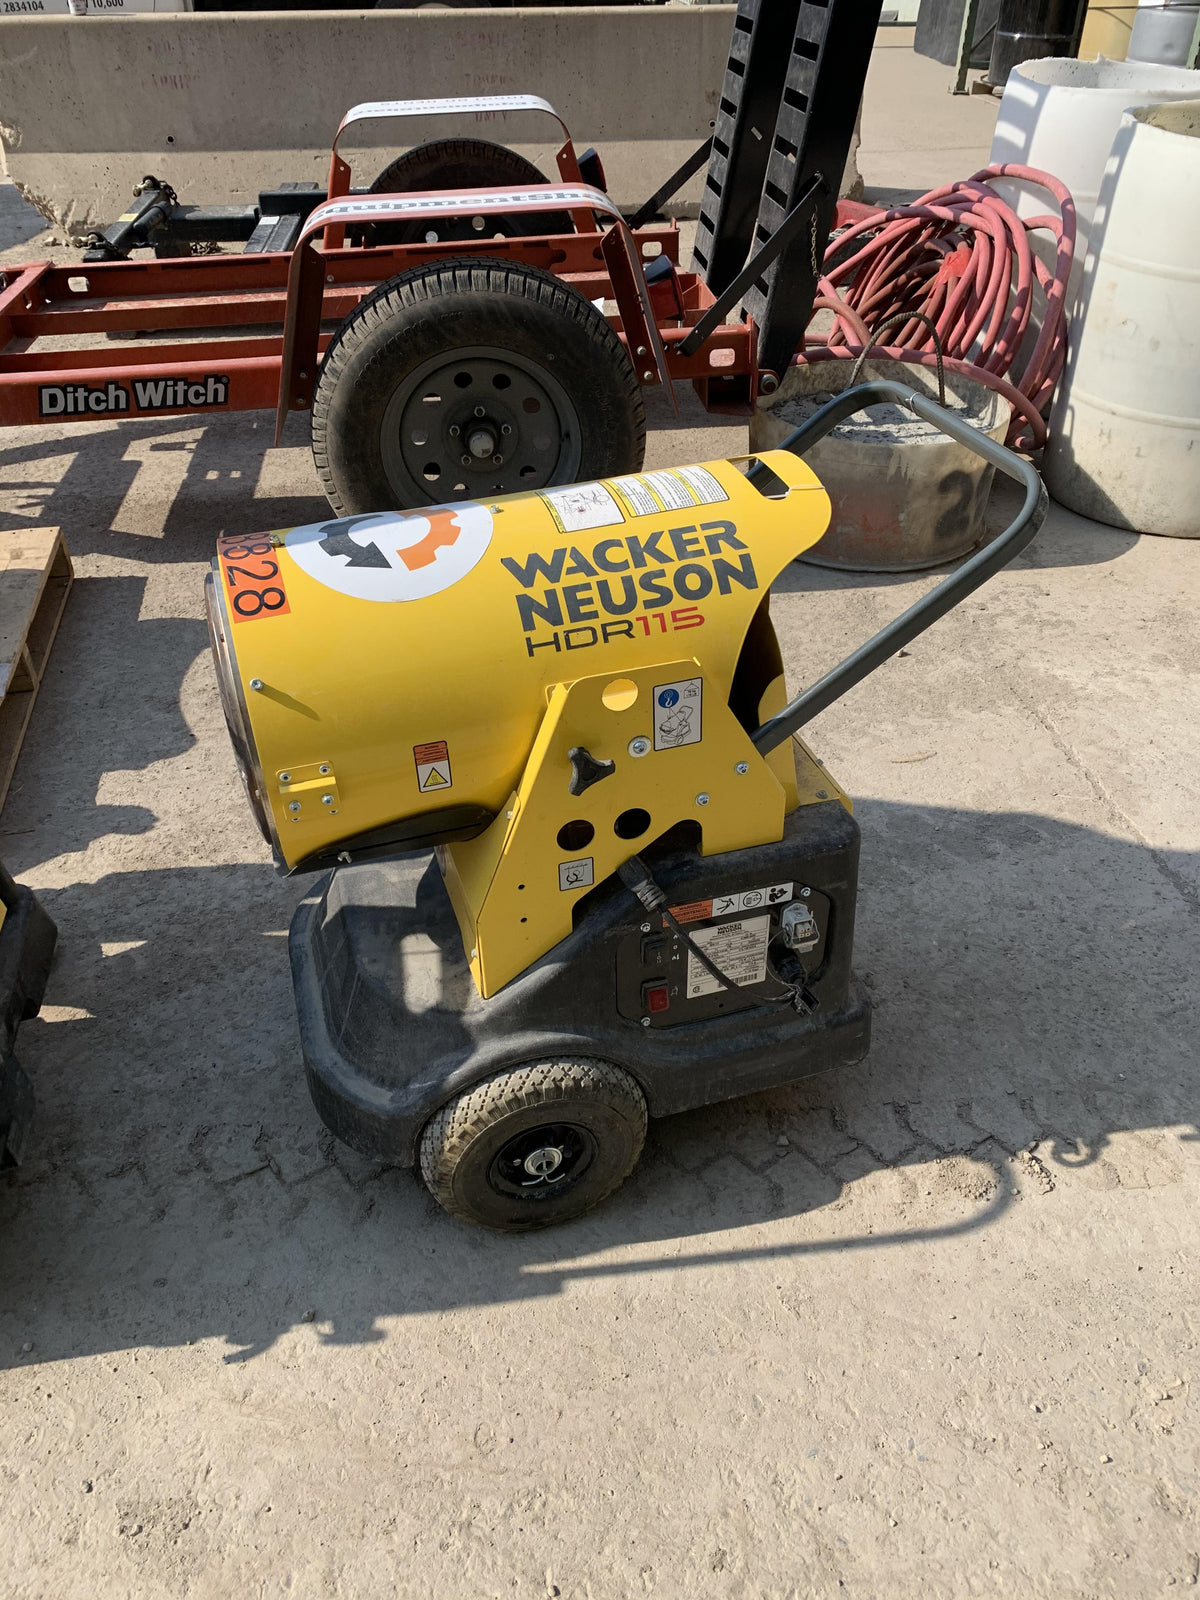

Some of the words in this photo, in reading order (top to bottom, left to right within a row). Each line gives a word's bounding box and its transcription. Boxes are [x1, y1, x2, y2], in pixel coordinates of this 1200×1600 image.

[4, 2, 44, 13] 2834104
[40, 383, 127, 415] Ditch
[134, 377, 226, 409] Witch
[501, 520, 749, 588] WACKER
[515, 553, 759, 632] NEUSON
[525, 606, 705, 657] HDR115
